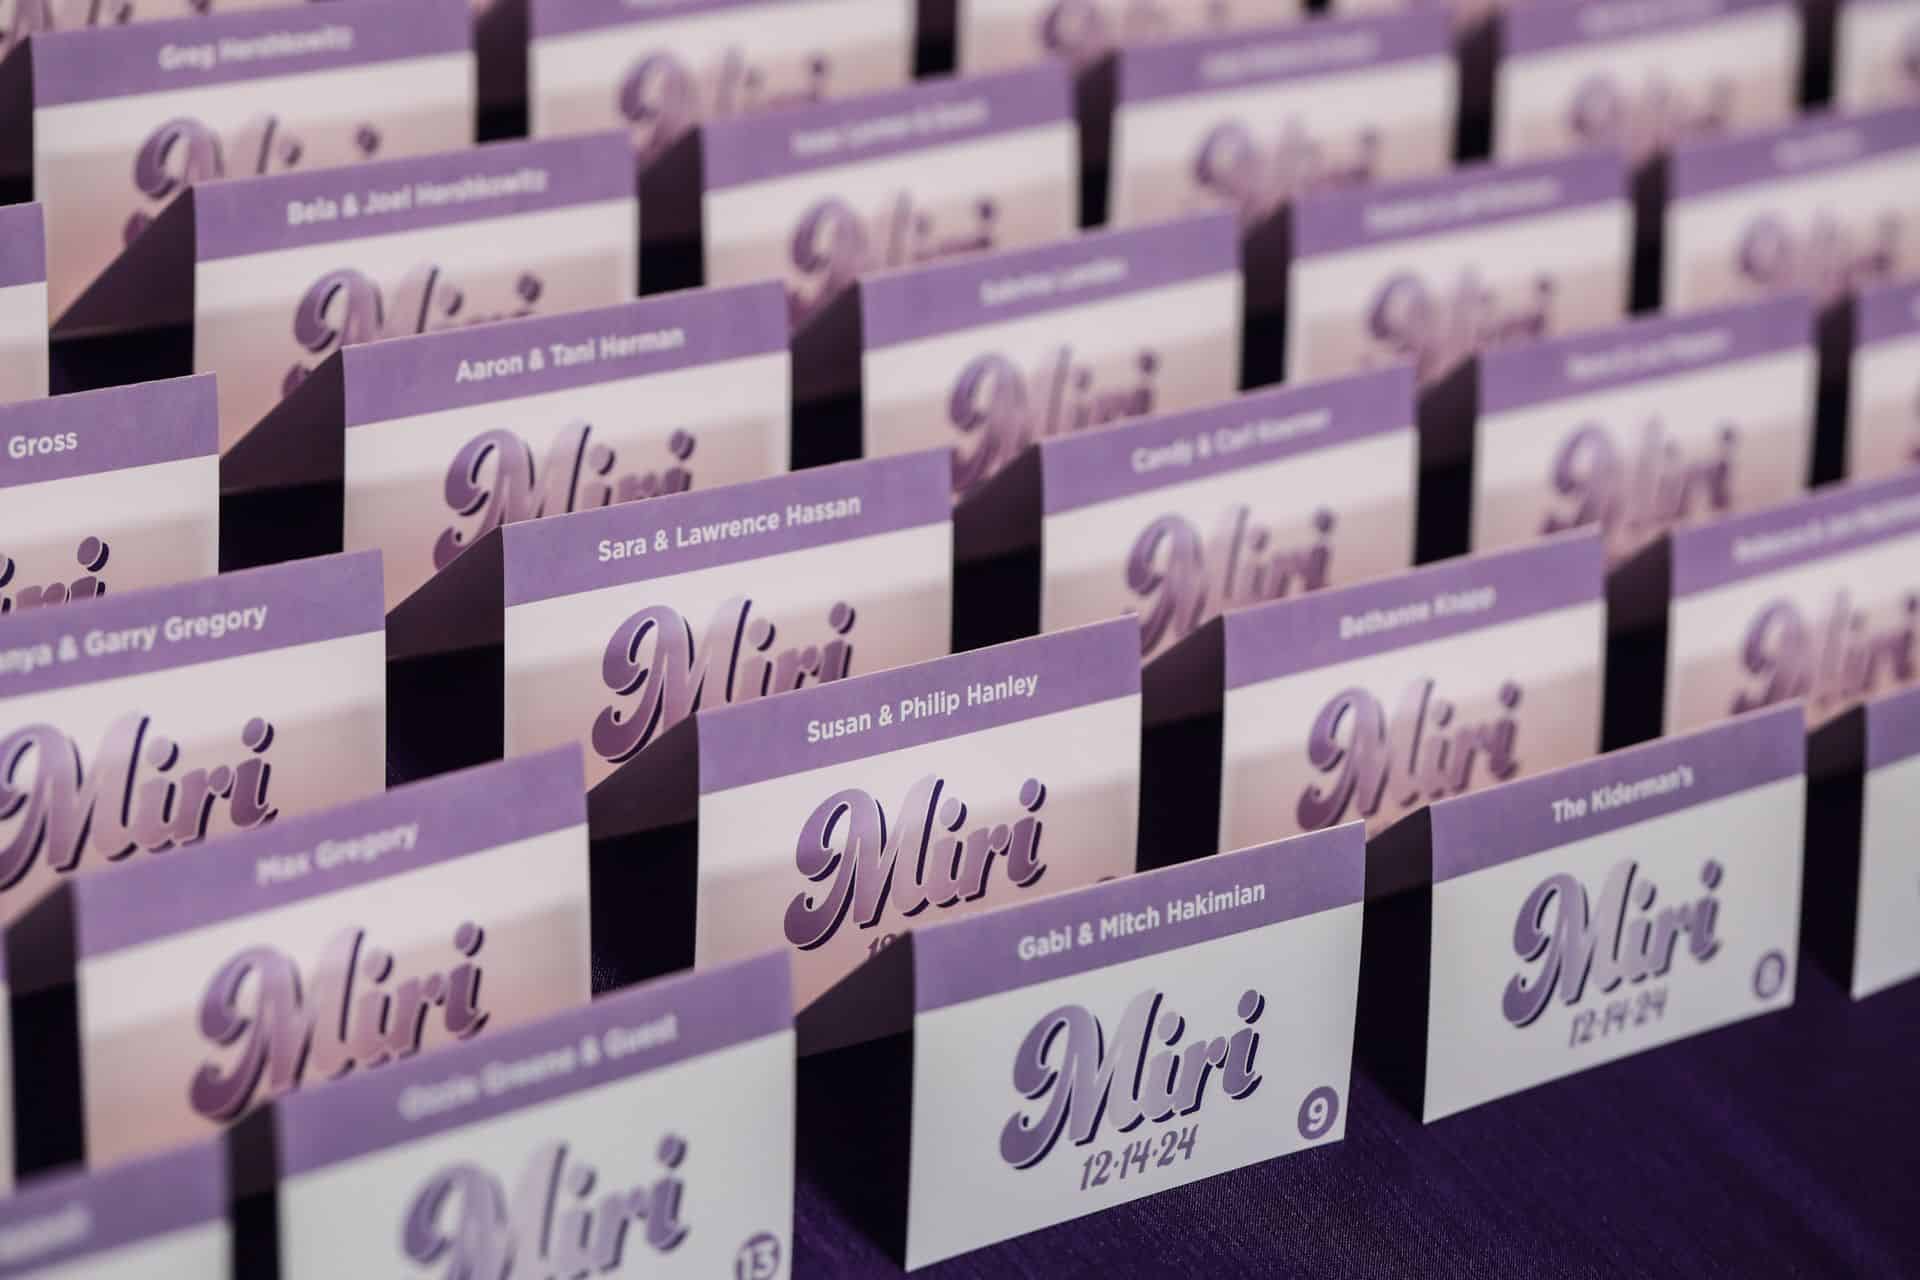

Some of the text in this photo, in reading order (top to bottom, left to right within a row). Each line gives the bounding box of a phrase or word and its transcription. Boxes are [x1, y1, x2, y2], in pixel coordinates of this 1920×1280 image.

[341, 191, 359, 218] &
[456, 327, 686, 384] Aaron & Tani Herman
[8, 432, 78, 459] Gross
[597, 496, 862, 562] Sara & Lawrence Hassan
[58, 634, 79, 662] &
[84, 625, 158, 657] Garry
[164, 605, 268, 642] Gregory
[806, 674, 1038, 743] Susan & Philip Hanley
[1296, 679, 1524, 831] Miri
[1551, 798, 1588, 825] The
[315, 821, 420, 870] Gregory
[783, 773, 1048, 951] Miri
[1017, 883, 1266, 961] Gabi & Mitch Hakimian
[1502, 859, 1724, 1029] Miri
[188, 920, 491, 1125] Miri
[578, 1033, 600, 1067] &
[1000, 987, 1266, 1170] Miri
[1308, 1097, 1329, 1131] 9
